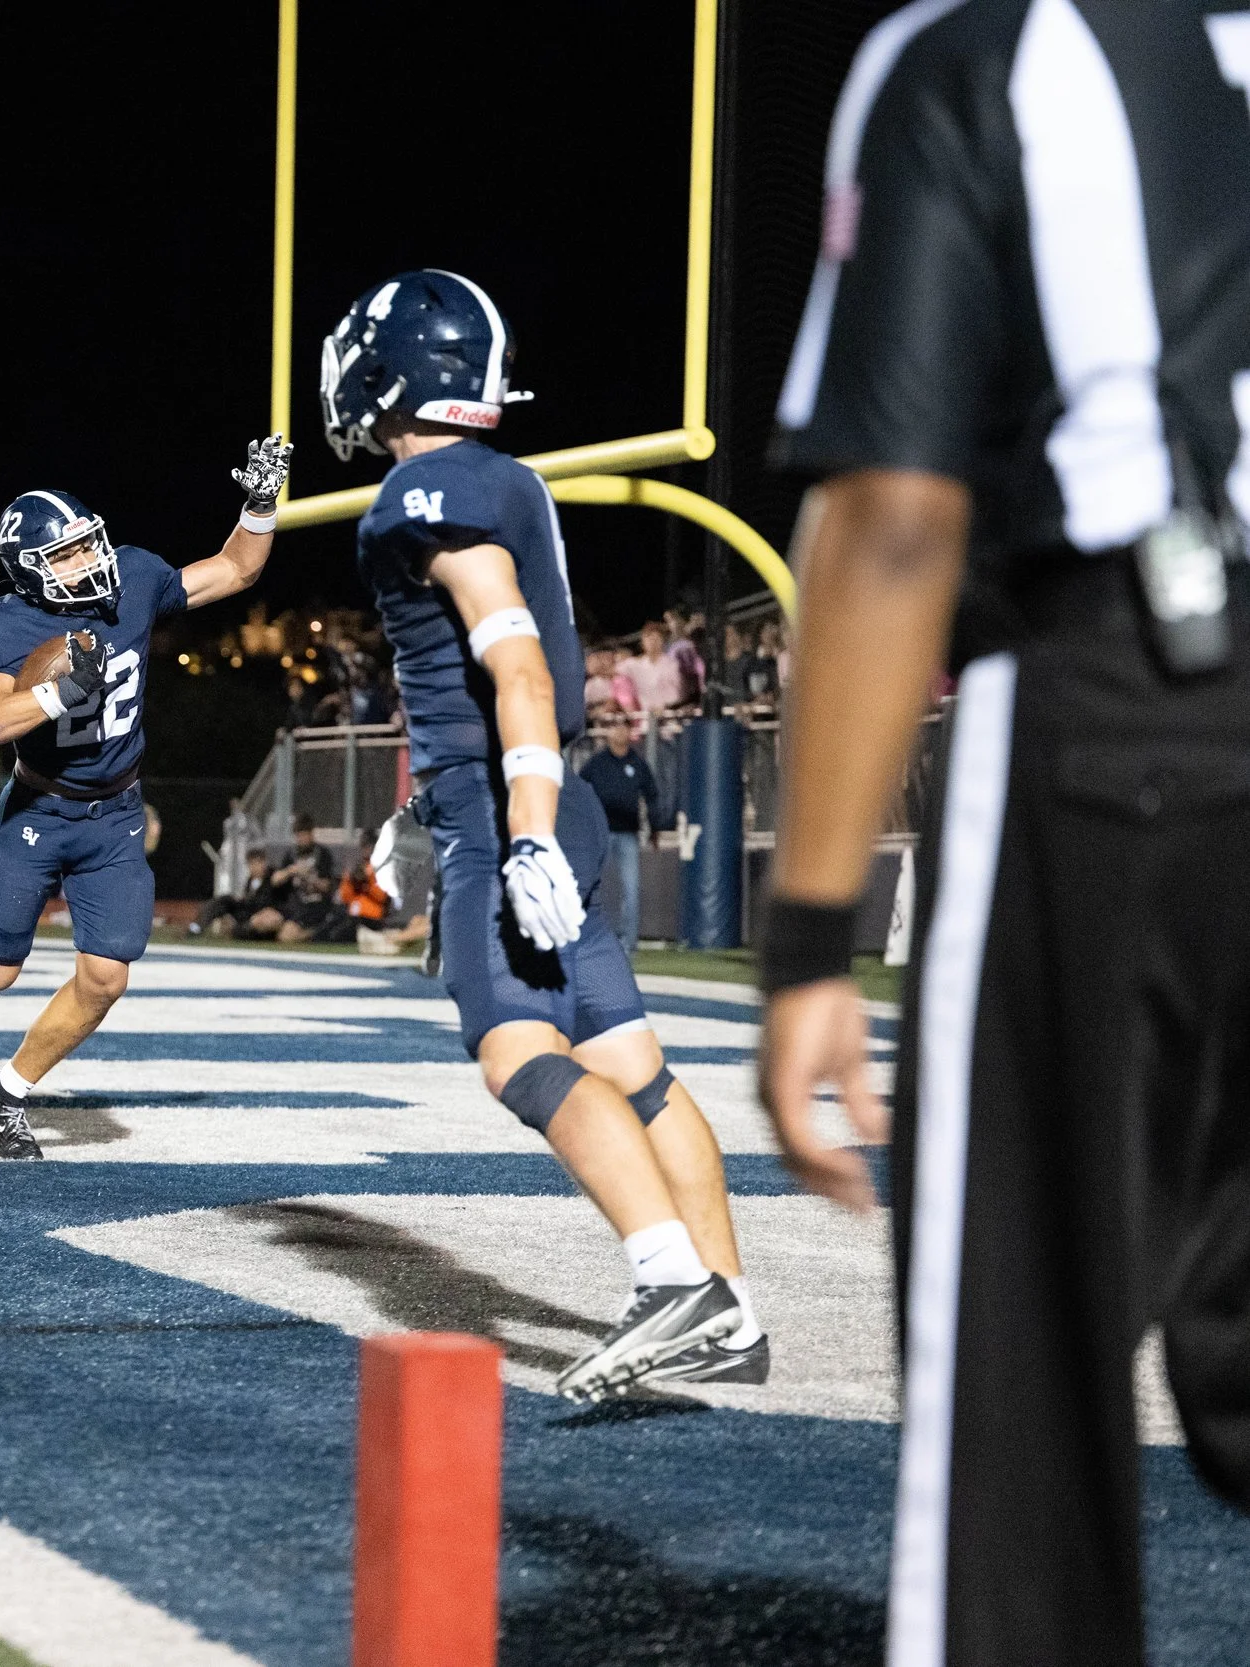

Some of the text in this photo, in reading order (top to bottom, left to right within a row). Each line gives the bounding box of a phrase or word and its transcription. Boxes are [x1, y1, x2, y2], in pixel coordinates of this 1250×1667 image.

[403, 488, 444, 522] SV
[0, 510, 23, 545] 22
[21, 826, 40, 846] SV
